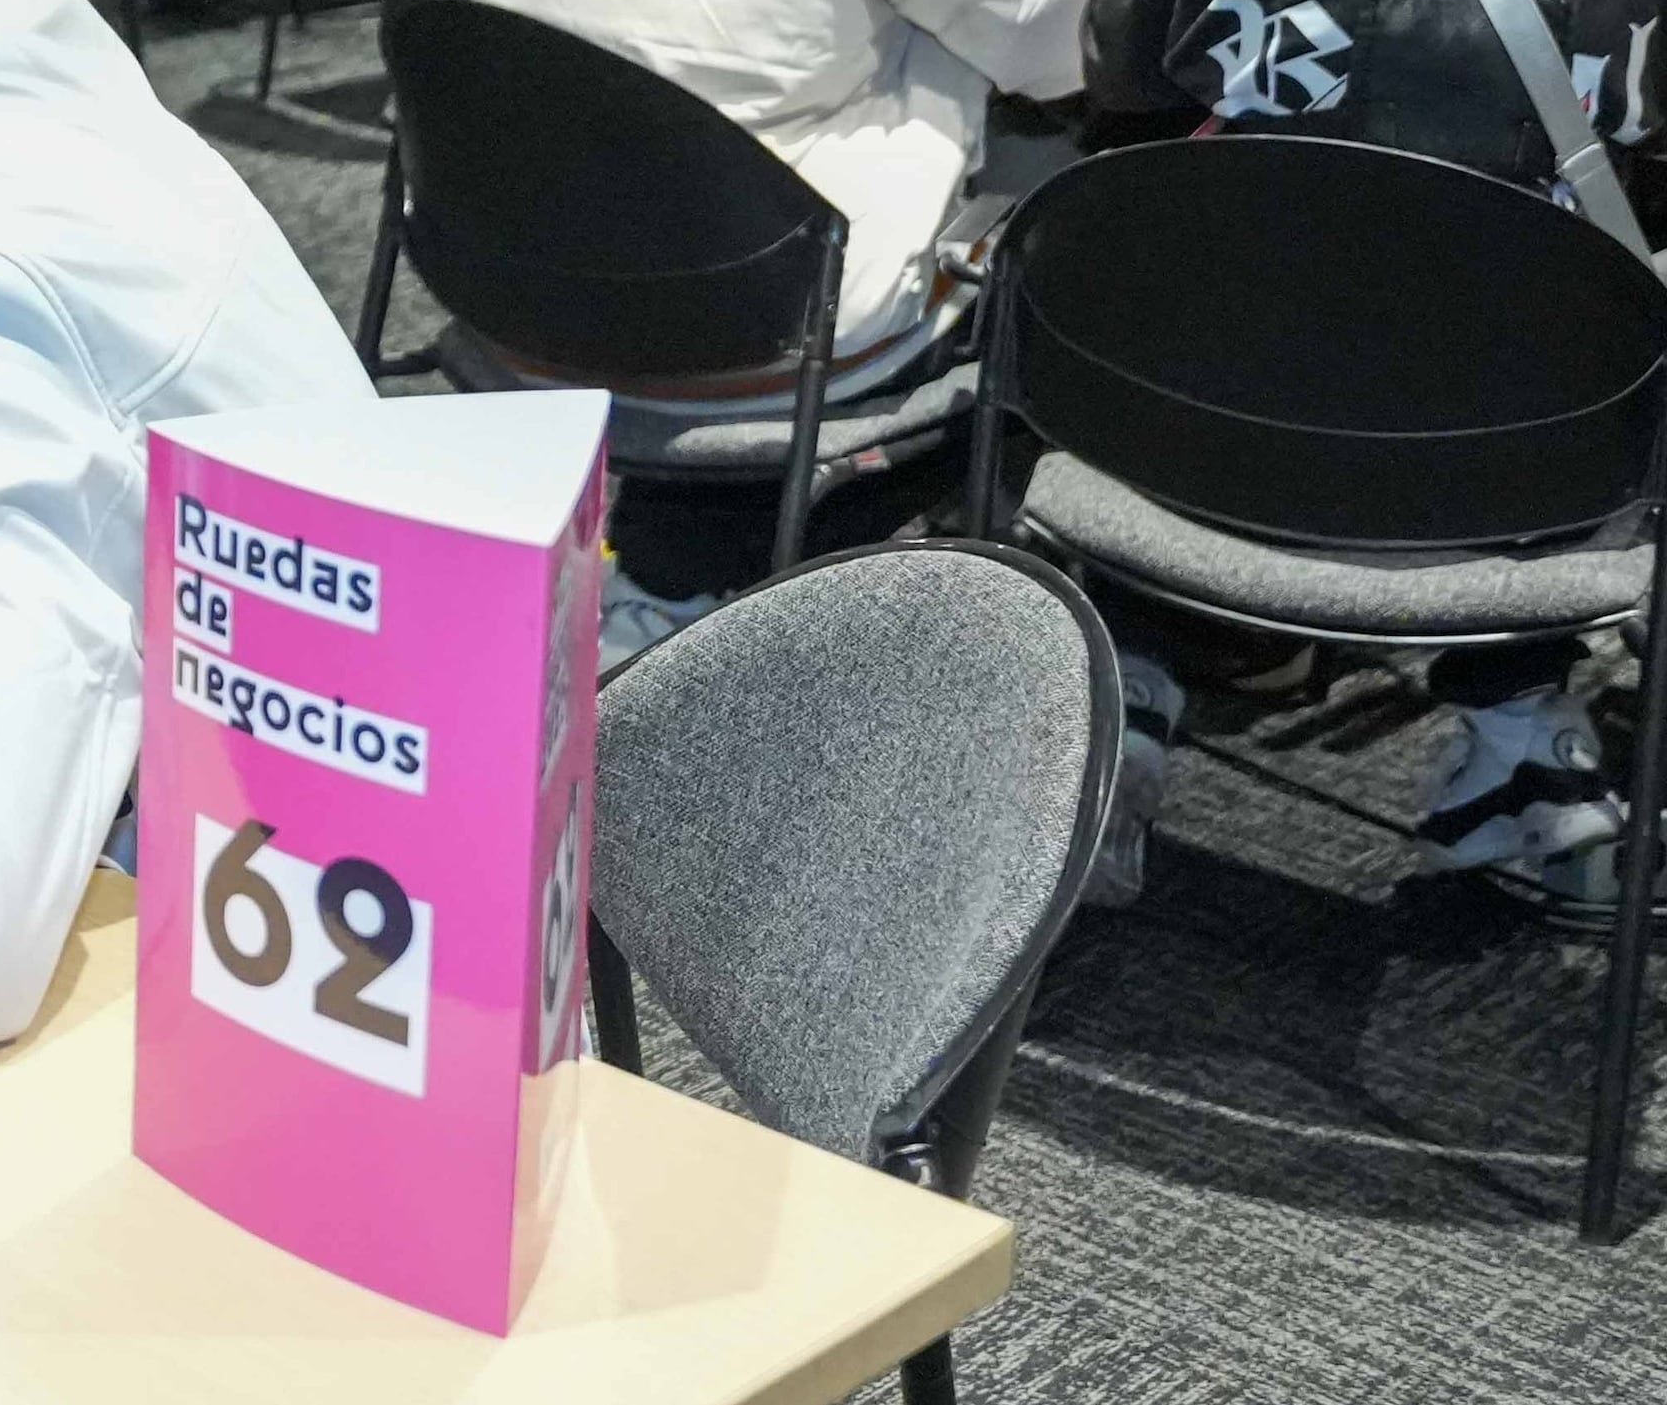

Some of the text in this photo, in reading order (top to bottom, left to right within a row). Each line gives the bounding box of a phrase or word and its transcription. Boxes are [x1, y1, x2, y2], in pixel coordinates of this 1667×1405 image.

[176, 571, 228, 637] de
[178, 492, 373, 613] Ruedas
[176, 649, 421, 775] negocios
[203, 817, 414, 1048] 62
